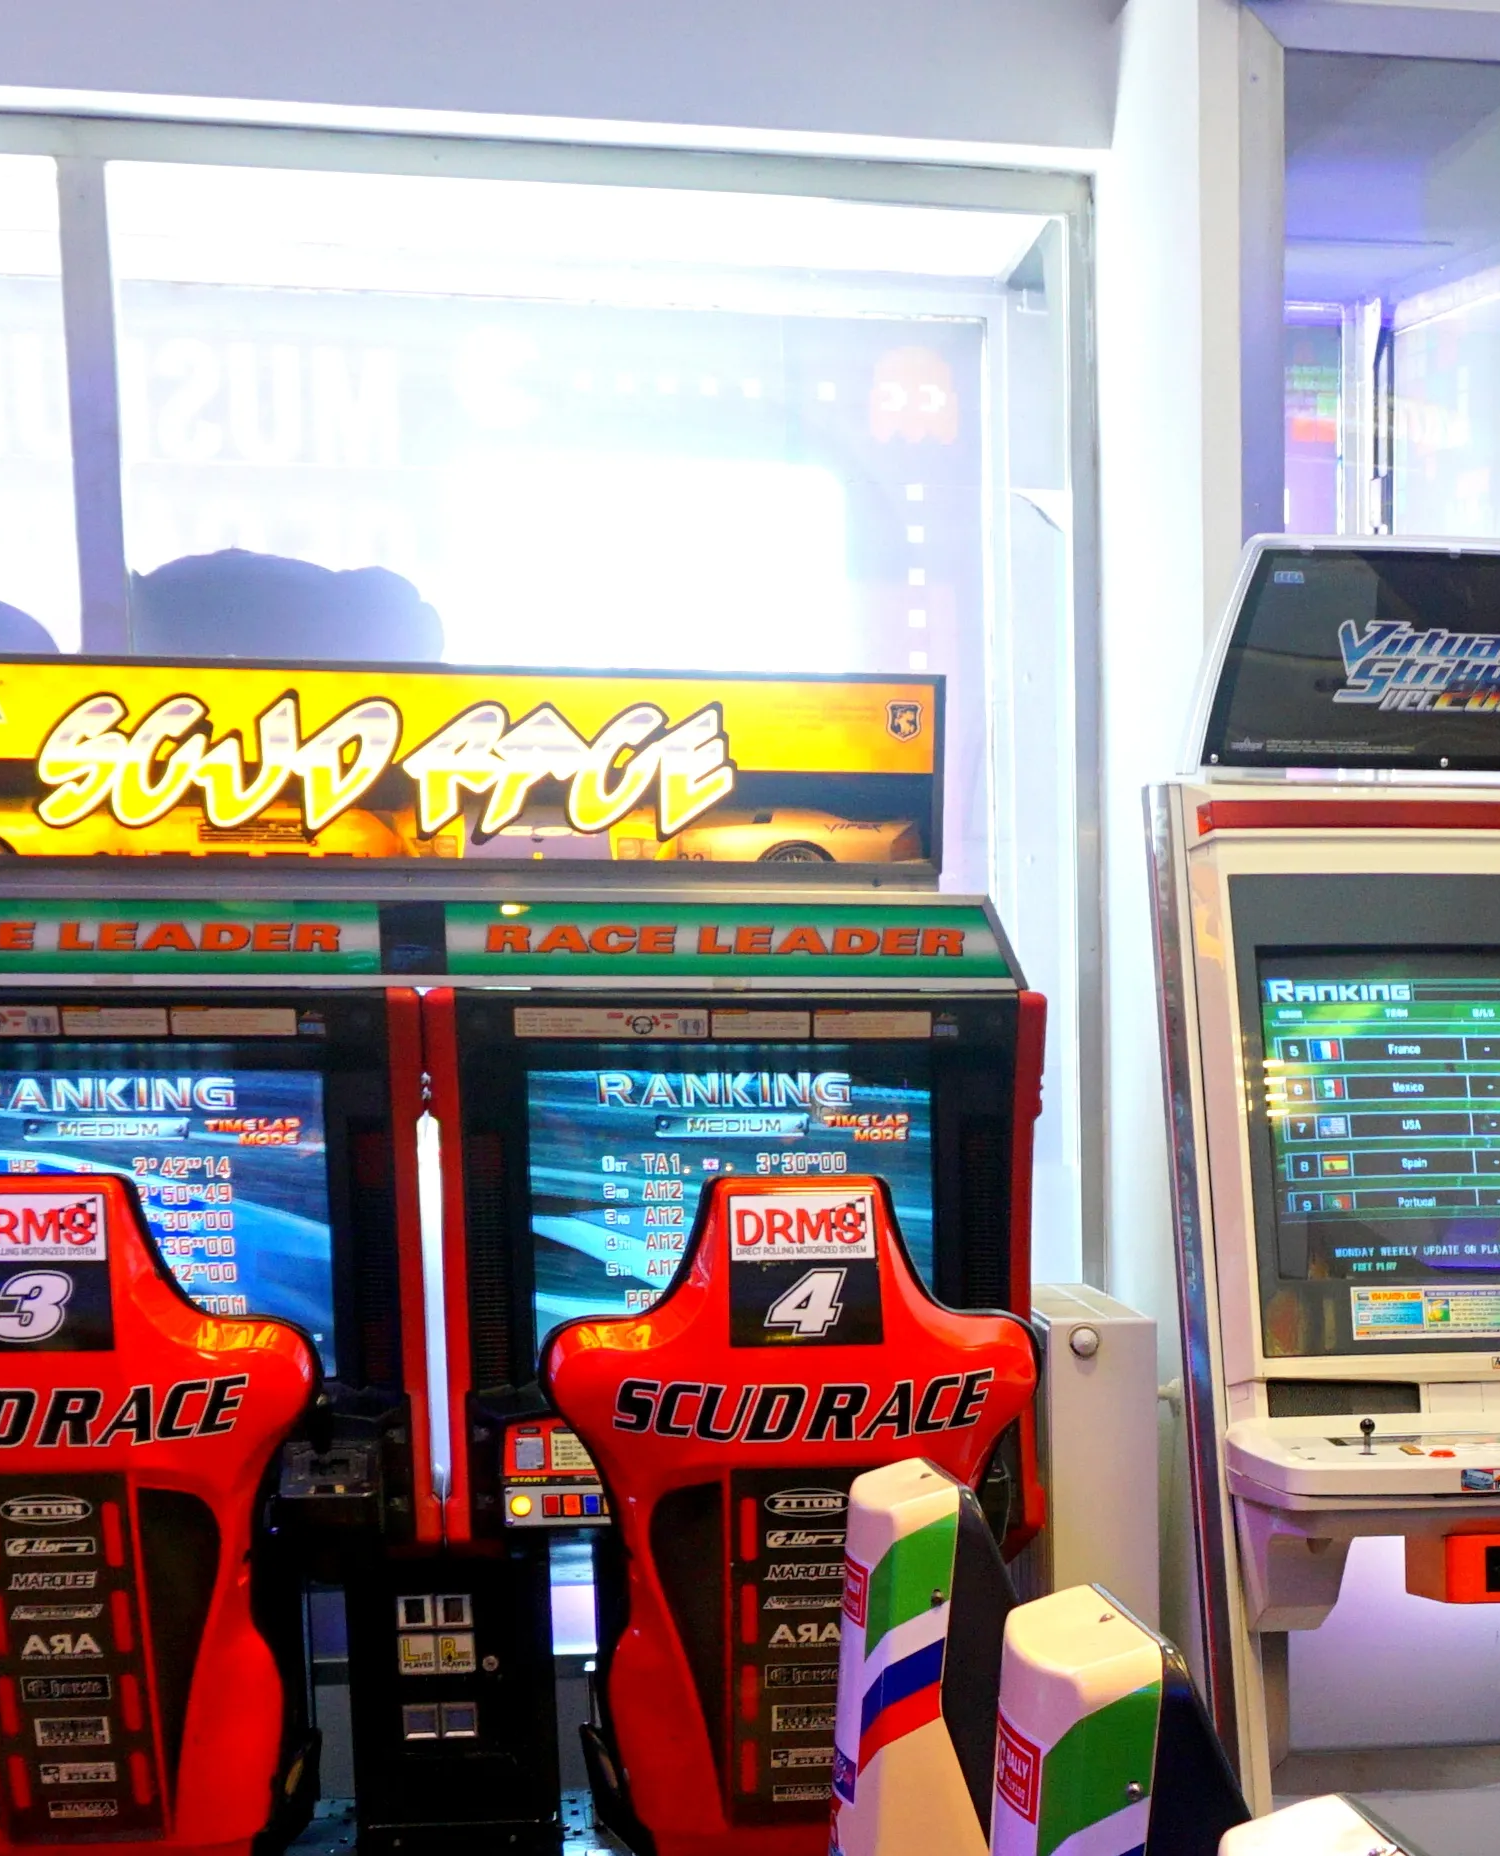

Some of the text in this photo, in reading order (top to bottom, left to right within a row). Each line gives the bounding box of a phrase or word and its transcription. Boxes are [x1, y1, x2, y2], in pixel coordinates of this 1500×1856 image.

[37, 690, 736, 842] SCUD RACE
[56, 921, 341, 953] LEADER
[484, 925, 966, 957] RACE LEADER
[1290, 1046, 1299, 1057] 5
[1387, 1043, 1422, 1055] France
[595, 1071, 853, 1108] RANKING
[1392, 1081, 1425, 1093] Mexico
[57, 1121, 160, 1138] MEDIUM
[687, 1117, 781, 1133] MEDIUM
[1402, 1119, 1422, 1132] USA
[238, 1131, 300, 1146] MODE
[853, 1127, 908, 1141] MODE
[1401, 1158, 1428, 1170] Spain
[642, 1180, 683, 1201] AM2
[1303, 1200, 1313, 1211] 9
[1397, 1196, 1437, 1210] Portugal
[644, 1207, 684, 1226] AM2
[735, 1208, 862, 1245] DRMS
[645, 1233, 684, 1250] AM2
[20, 1247, 67, 1257] MOTORIZED
[67, 1247, 98, 1257] SYSTEM
[736, 1245, 867, 1256] DIRECT ROLLING MOTORIZED SYSTEM
[1335, 1246, 1375, 1258] MONDAY
[1379, 1246, 1419, 1258] WEEKLY
[1423, 1246, 1460, 1258] UPDATE
[1464, 1246, 1477, 1257] ON
[1352, 1262, 1375, 1273] FREE
[764, 1267, 848, 1337] 4
